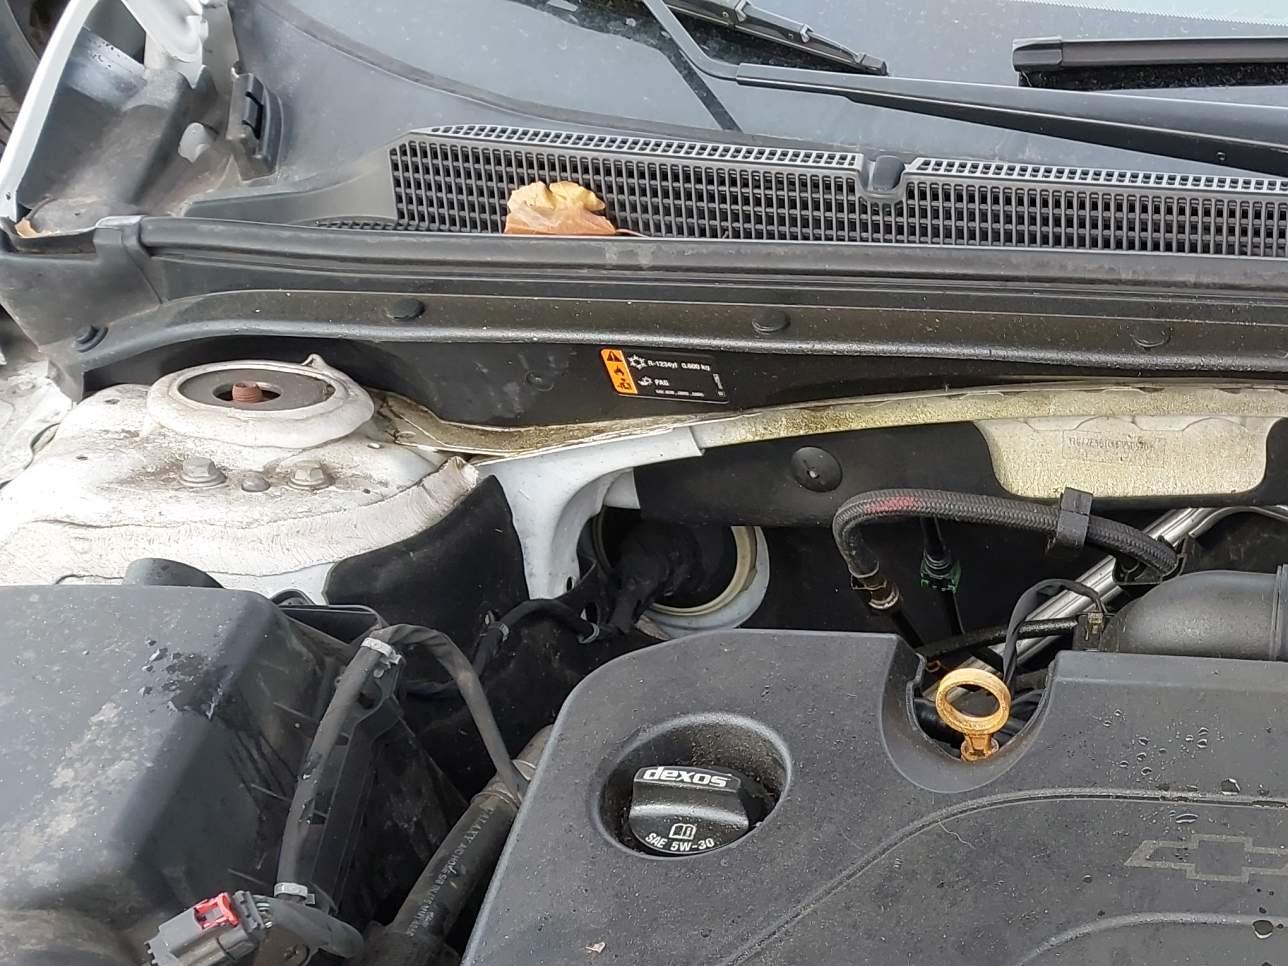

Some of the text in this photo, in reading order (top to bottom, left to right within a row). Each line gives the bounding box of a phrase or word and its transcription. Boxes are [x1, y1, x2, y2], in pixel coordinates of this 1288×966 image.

[643, 766, 732, 788] dexos
[645, 833, 715, 851] SAE 5W-30
